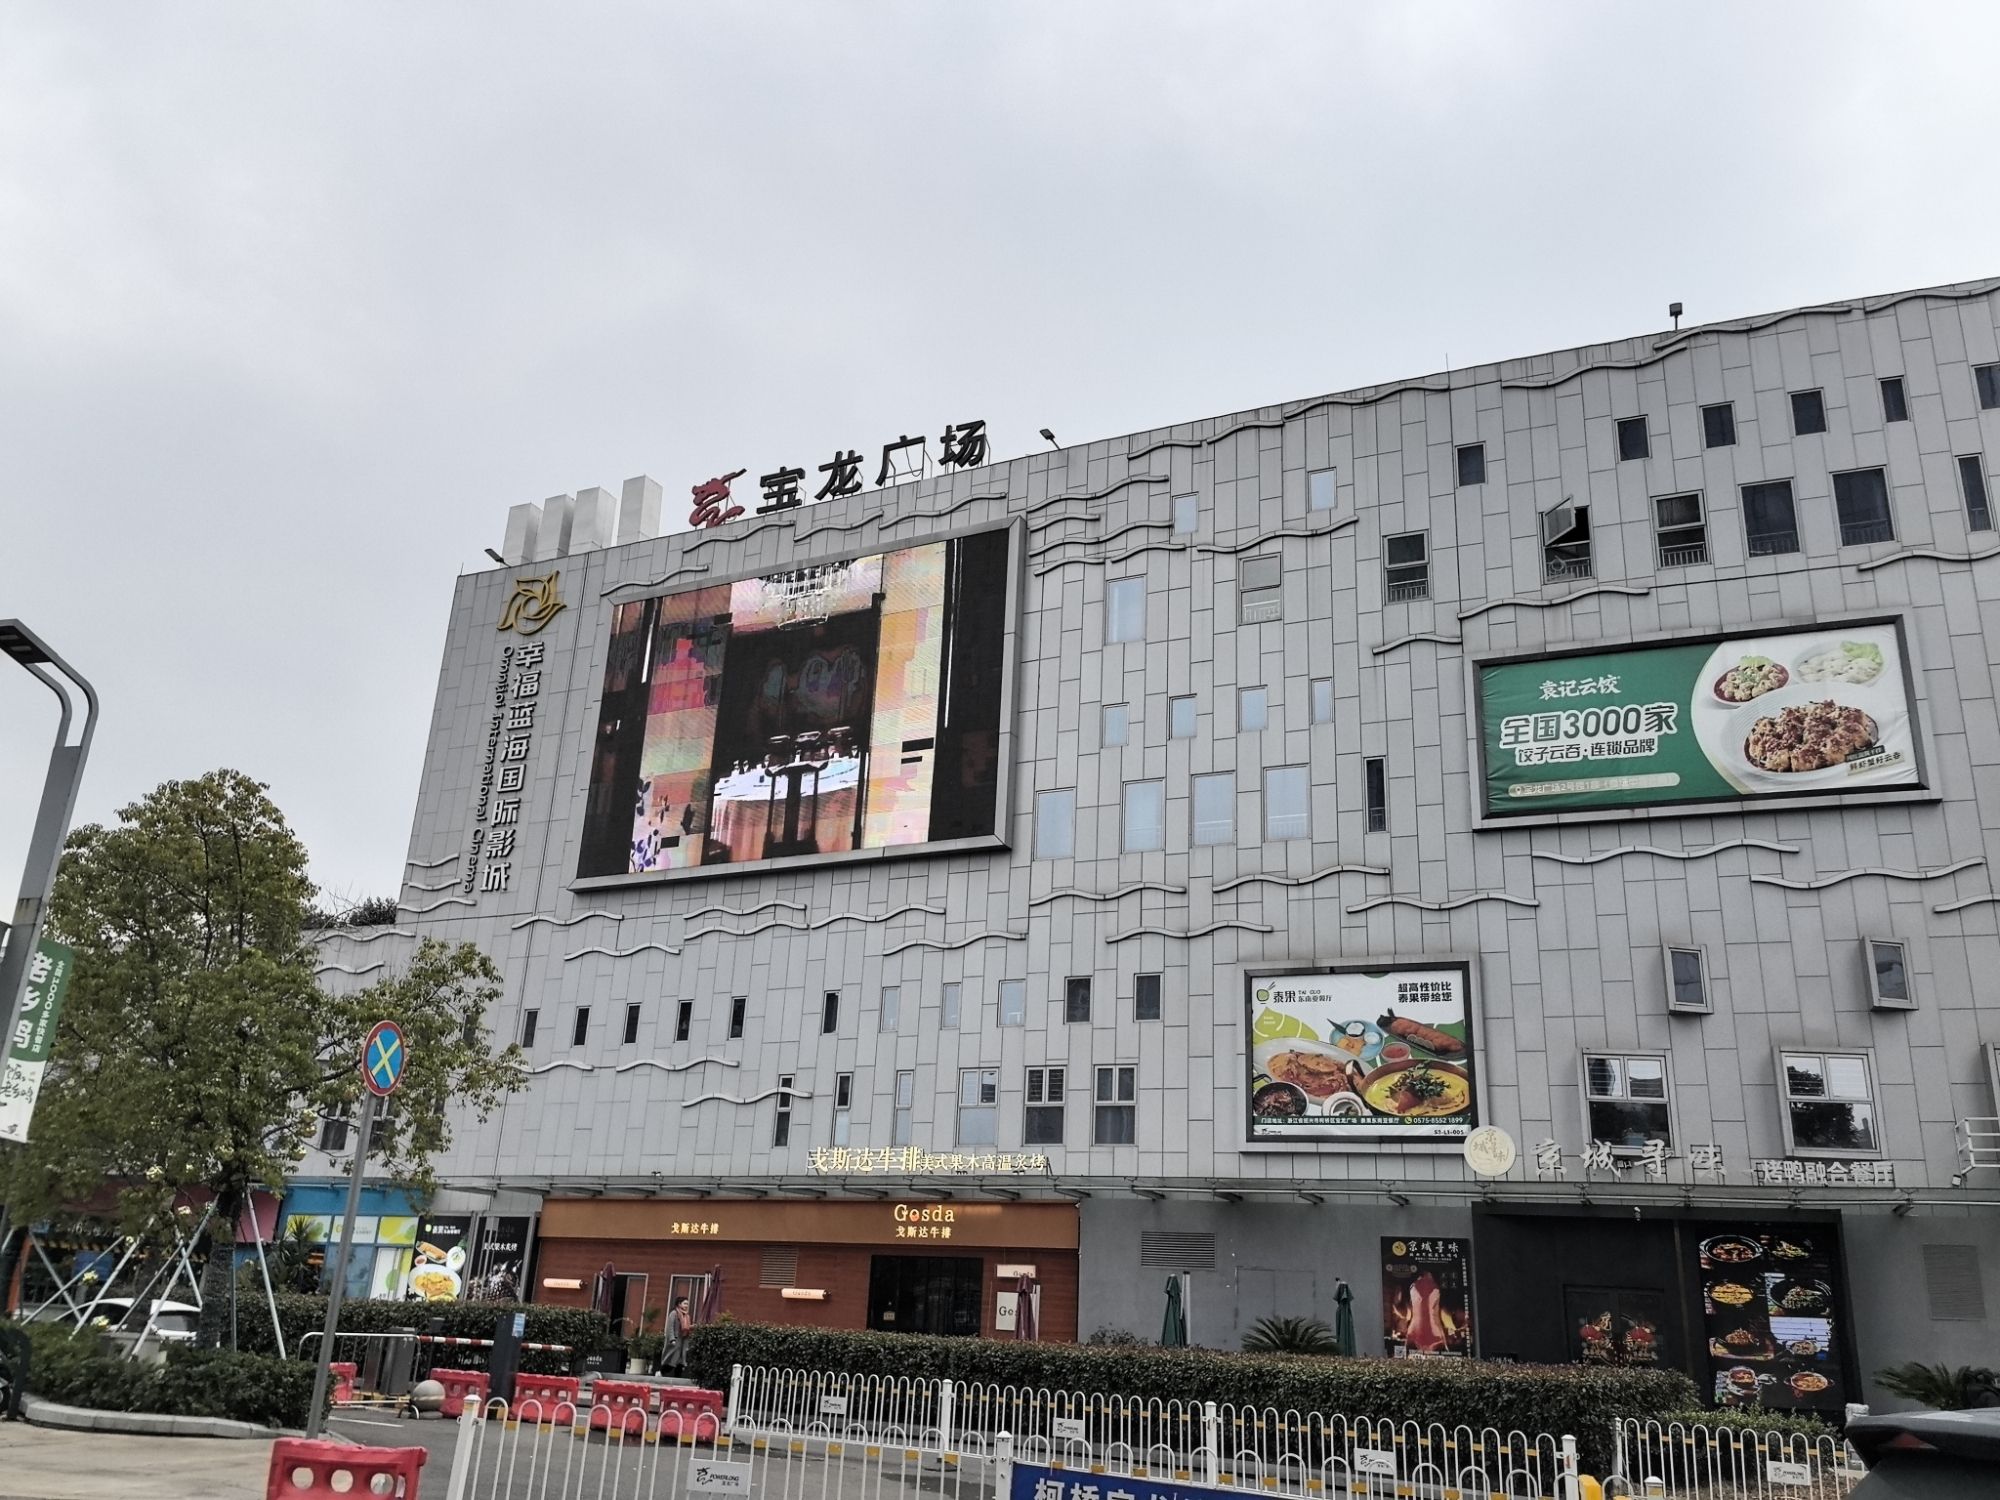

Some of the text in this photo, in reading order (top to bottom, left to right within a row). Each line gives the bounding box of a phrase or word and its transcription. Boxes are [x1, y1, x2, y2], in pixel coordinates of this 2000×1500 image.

[756, 420, 987, 514] 宝龙广场
[1539, 675, 1621, 700] 袁记云饺
[1502, 704, 1676, 746] 全国3000家
[463, 645, 515, 893] Omnijoi International Cinema
[479, 641, 545, 893] 幸福蓝海国际影城
[1398, 981, 1452, 992] 超高性价比
[920, 1153, 1047, 1172] 美式果木高温炙烤
[1763, 1159, 1895, 1186] 烤鸭融合餐厅
[894, 1204, 955, 1222] Gosda
[895, 1226, 952, 1239] 戈斯达牛排
